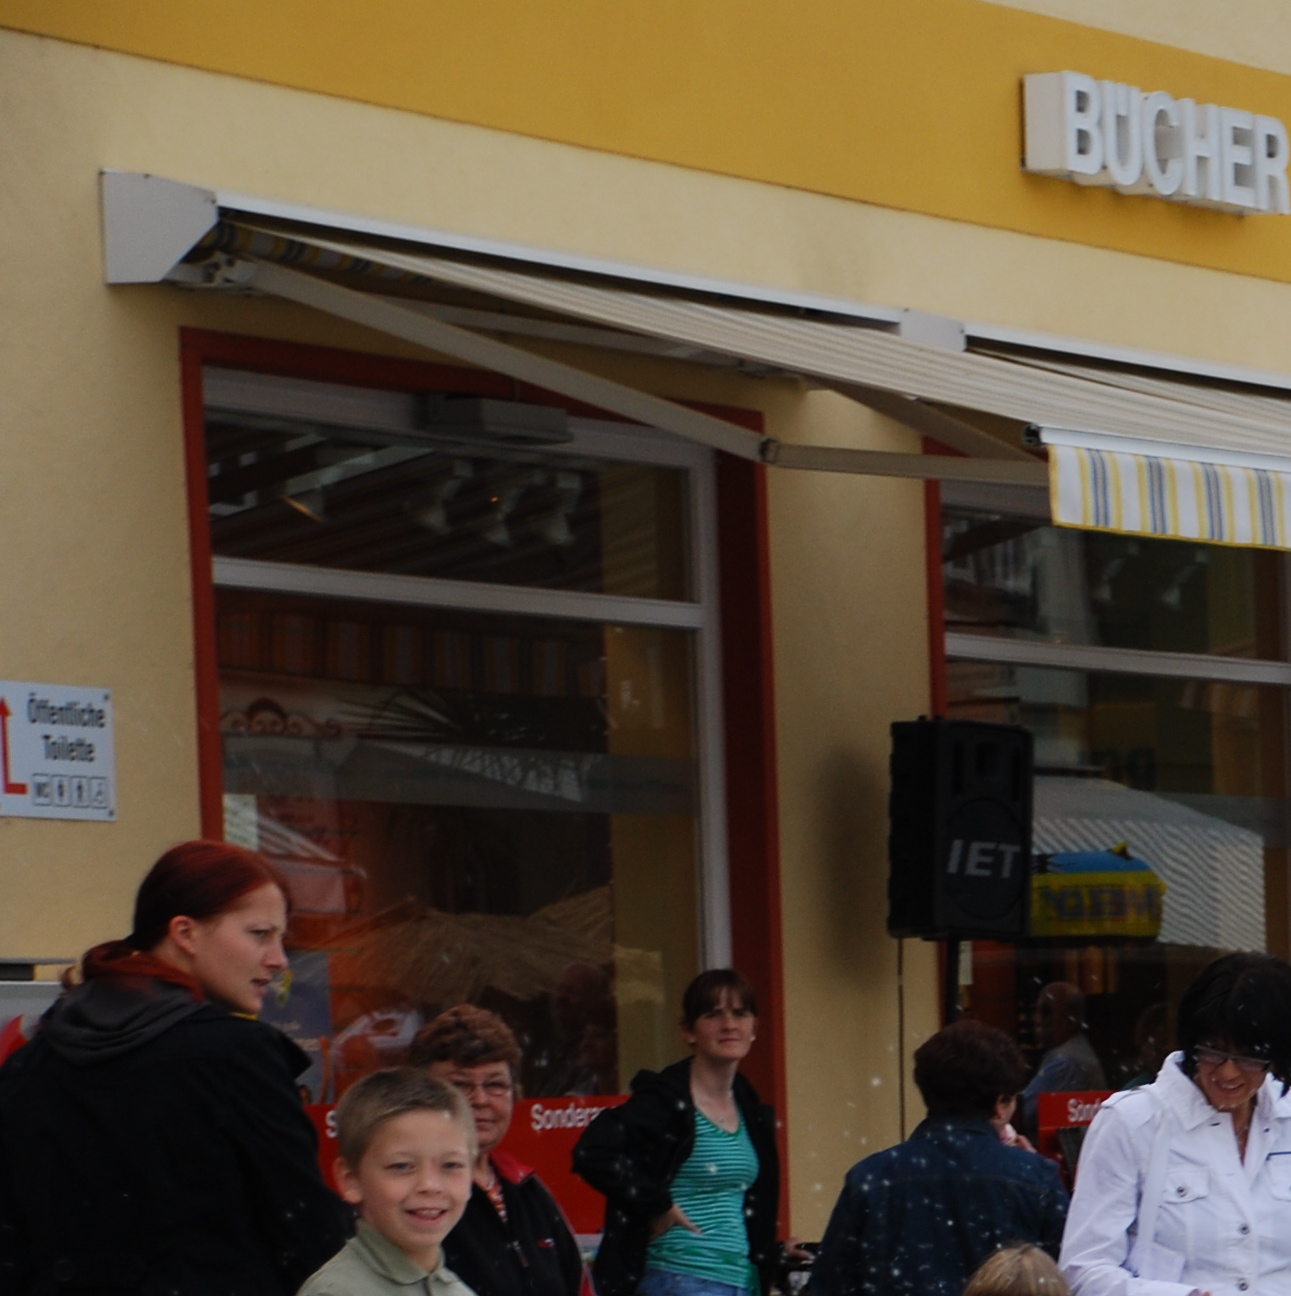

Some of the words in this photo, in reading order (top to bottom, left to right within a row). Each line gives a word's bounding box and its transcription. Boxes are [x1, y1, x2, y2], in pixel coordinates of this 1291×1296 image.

[1058, 70, 1291, 215] BÜCHER
[27, 691, 105, 728] Öffentliche
[42, 734, 95, 762] Toilette
[946, 839, 1022, 878] IET
[531, 1102, 605, 1130] Sonder
